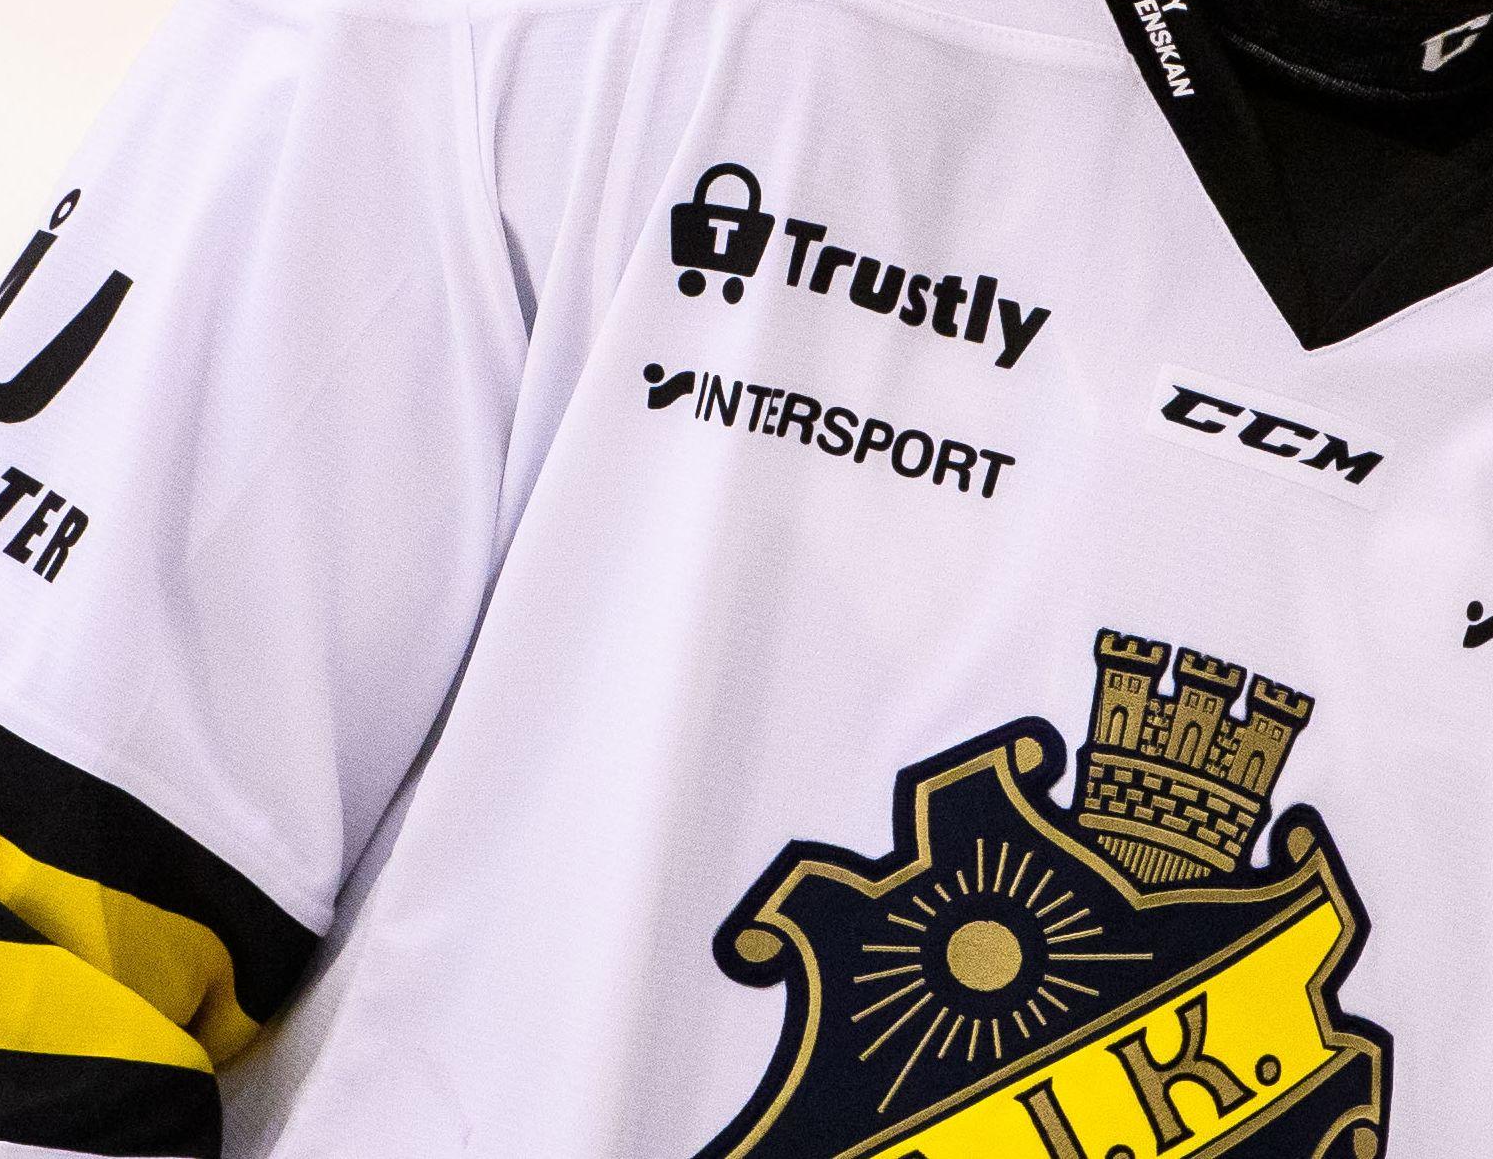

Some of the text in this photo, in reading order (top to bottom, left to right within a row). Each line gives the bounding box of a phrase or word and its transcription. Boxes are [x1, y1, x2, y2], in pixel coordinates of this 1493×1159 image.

[784, 217, 1052, 370] Trustly
[694, 371, 1016, 499] INTERSPORT
[1160, 384, 1385, 485] CCM
